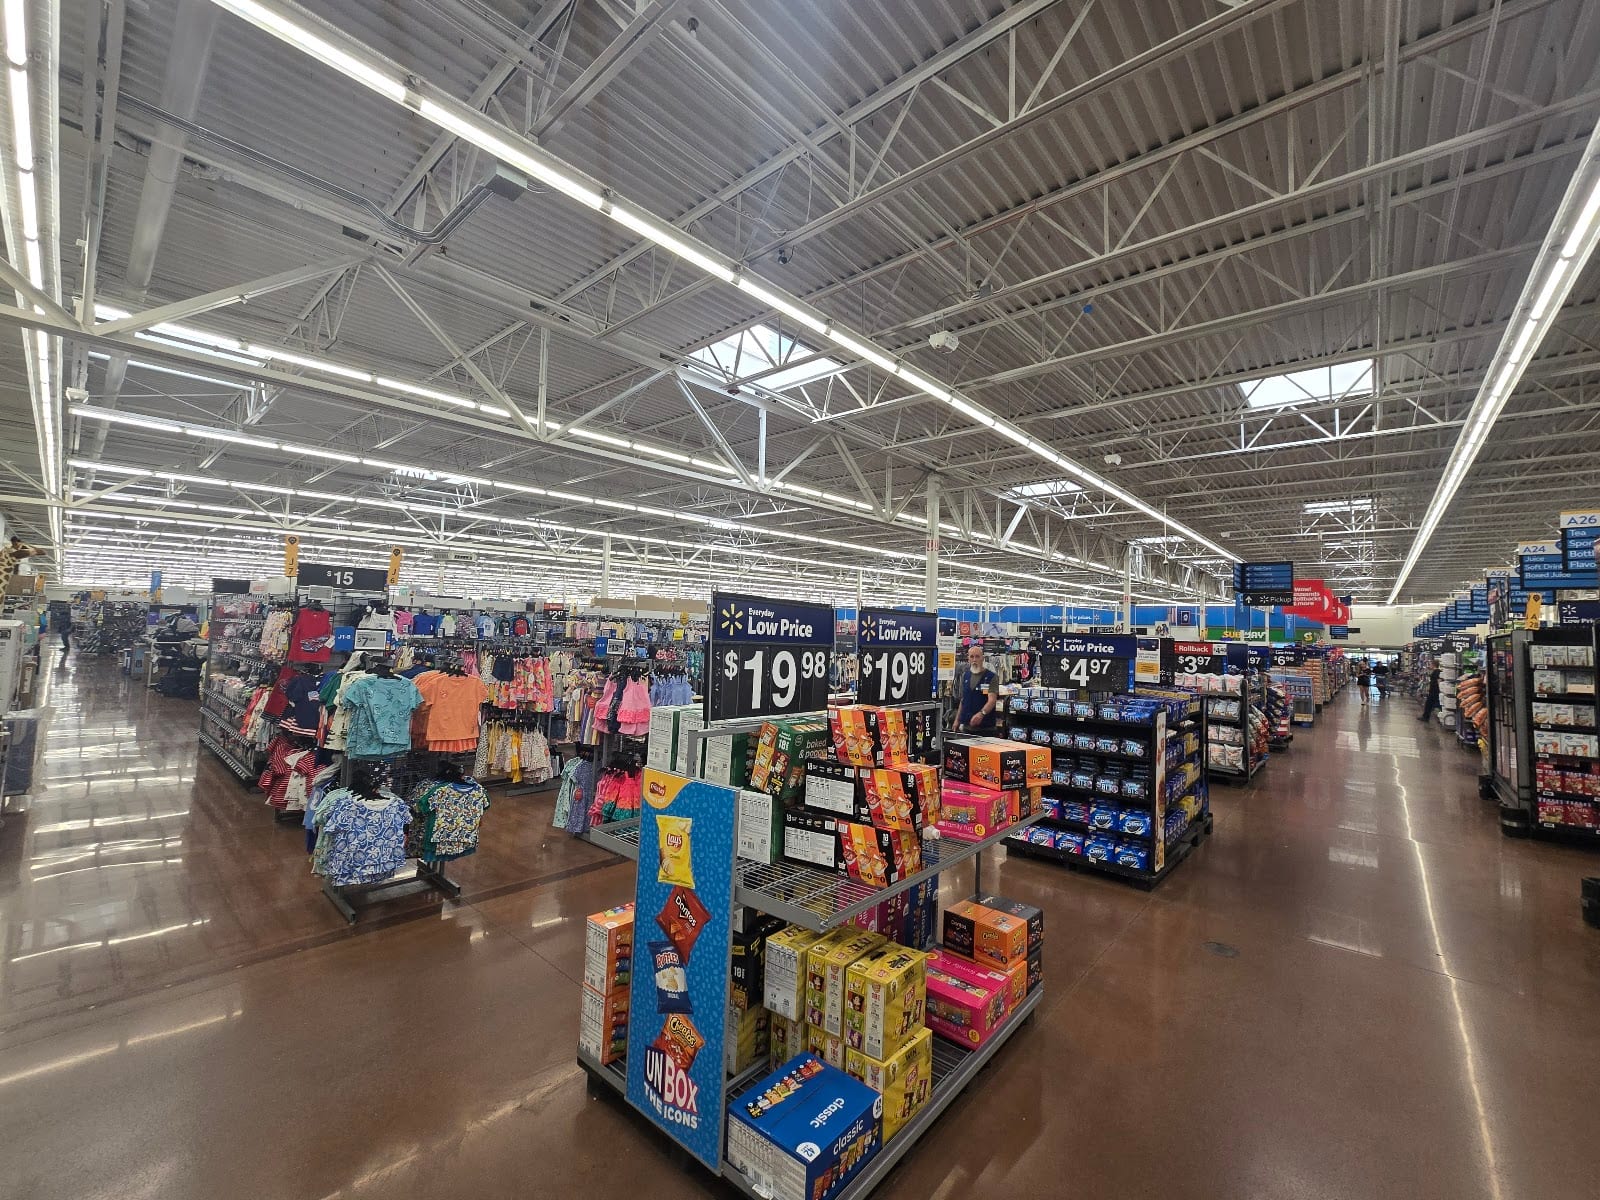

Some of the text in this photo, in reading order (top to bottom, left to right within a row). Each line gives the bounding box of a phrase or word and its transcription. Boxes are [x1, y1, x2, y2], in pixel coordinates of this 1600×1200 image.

[1567, 515, 1597, 525] A26
[1569, 529, 1586, 537] Tea
[1523, 545, 1546, 553] A24
[1569, 540, 1594, 548] Spor
[1569, 550, 1595, 558] Bottl
[1525, 563, 1541, 571] Soft
[748, 607, 775, 619] Everyday
[747, 615, 813, 638] Low Price
[878, 618, 897, 627] Everyday
[878, 626, 922, 641] Low Price
[1063, 642, 1115, 654] Low Price
[1178, 645, 1209, 653] Rollback
[806, 738, 827, 749] baked
[945, 821, 974, 833] family fun
[667, 833, 682, 848] Lay's
[675, 895, 698, 928] Doritos
[655, 951, 680, 969] RUFFLES
[670, 1016, 697, 1048] Cheetos
[643, 1082, 663, 1115] THE
[809, 1097, 845, 1129] classic
[833, 1119, 864, 1156] classic
